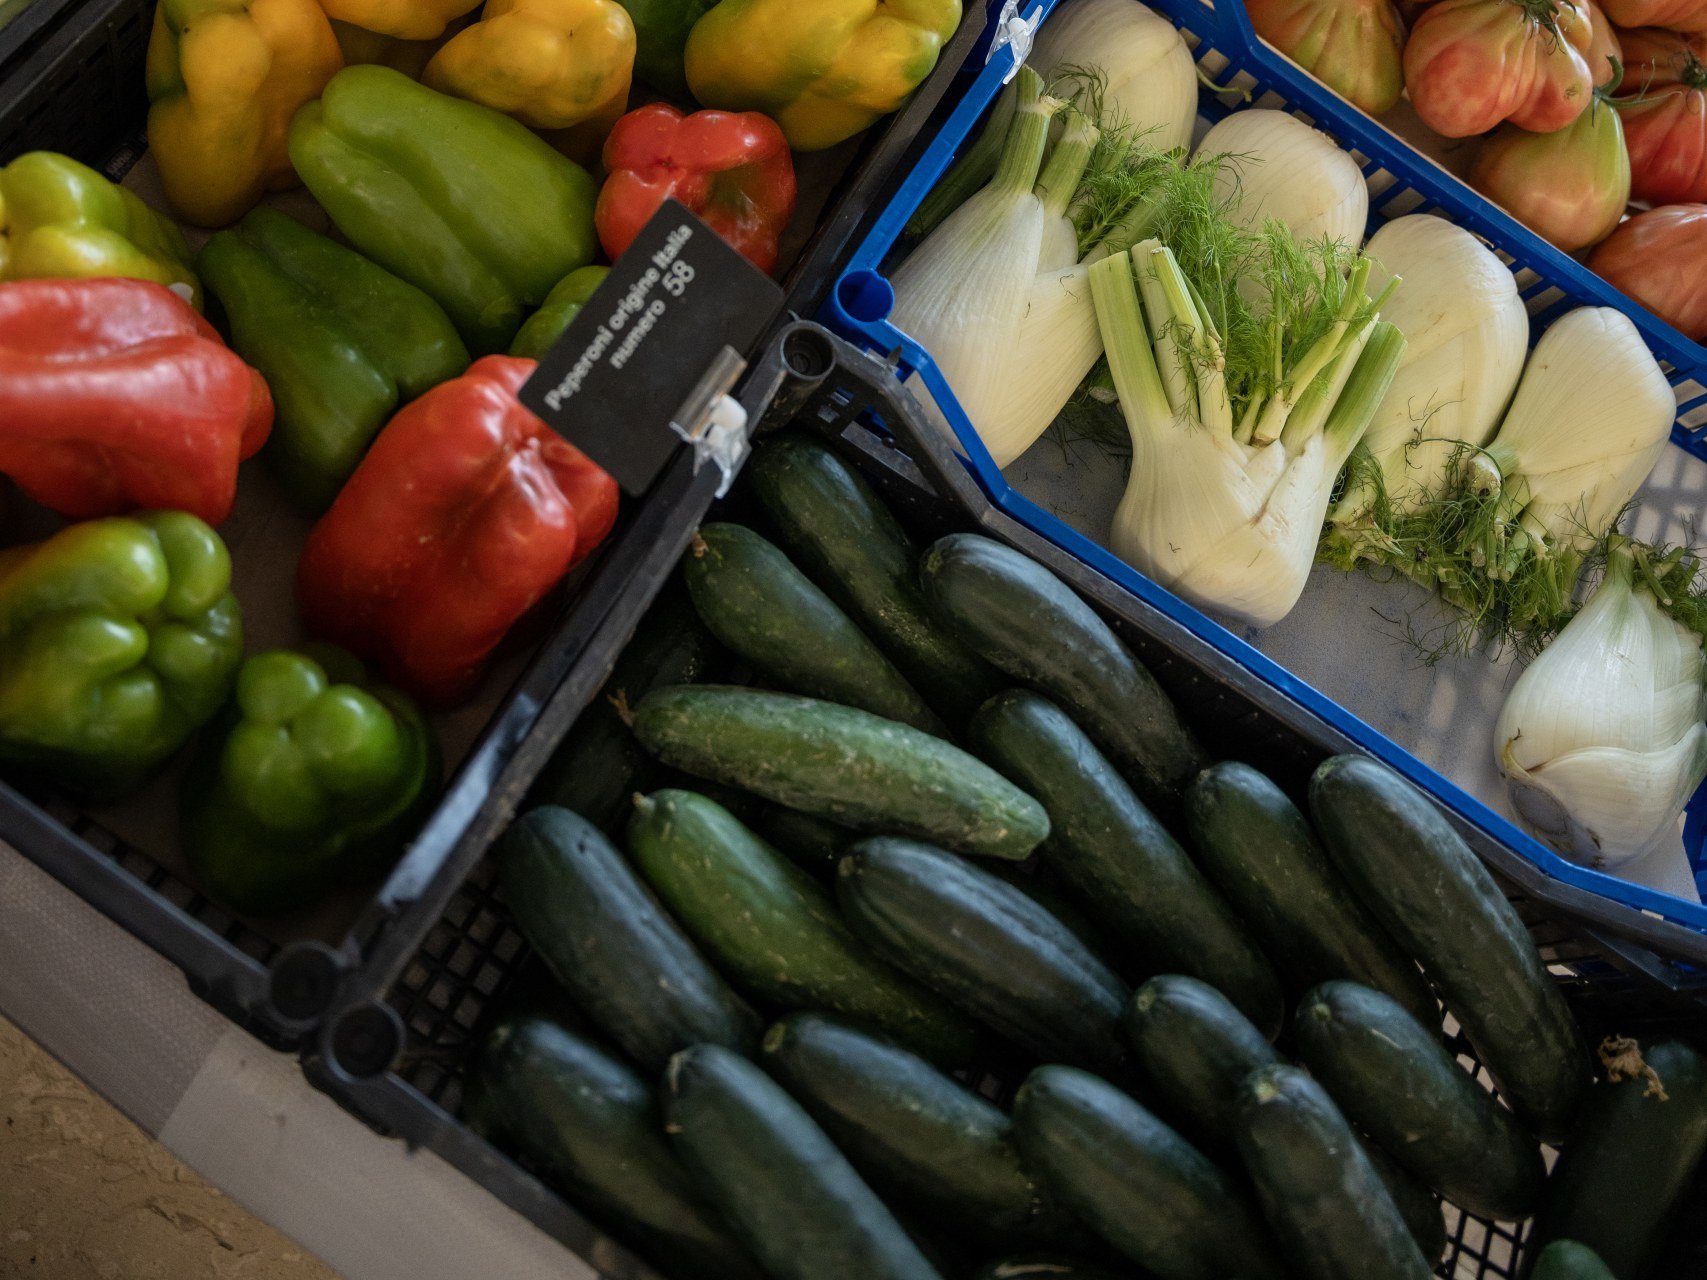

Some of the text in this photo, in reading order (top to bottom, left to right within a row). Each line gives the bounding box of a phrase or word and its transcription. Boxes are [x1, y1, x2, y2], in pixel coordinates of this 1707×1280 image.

[544, 224, 694, 411] Peperoni origine Italia
[609, 259, 696, 370] numero 58
